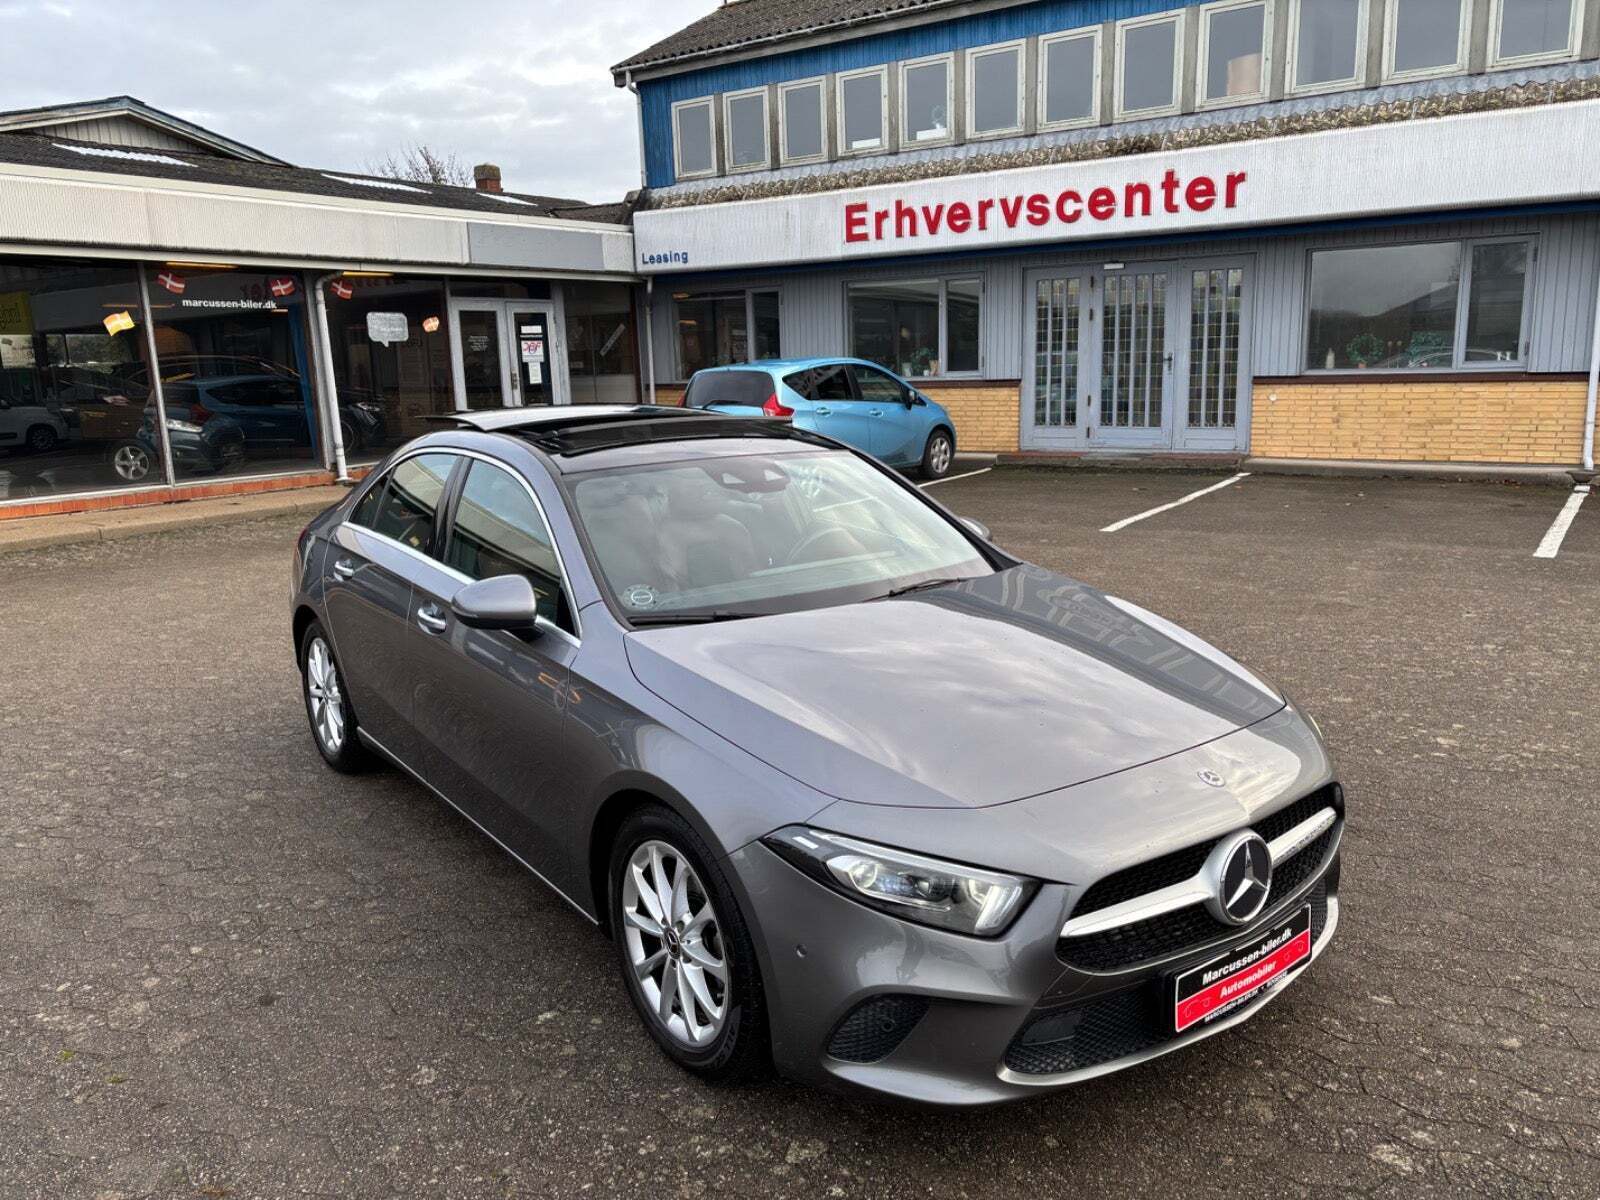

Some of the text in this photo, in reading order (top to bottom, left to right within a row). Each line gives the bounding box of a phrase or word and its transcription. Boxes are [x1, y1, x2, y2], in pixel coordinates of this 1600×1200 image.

[844, 169, 1246, 243] Erhvervscenter
[641, 250, 689, 264] Leasing
[182, 299, 277, 309] marcussen-biler.dk
[1202, 928, 1292, 985] Marcussen-biler.dk
[1220, 961, 1277, 999] Automobiler
